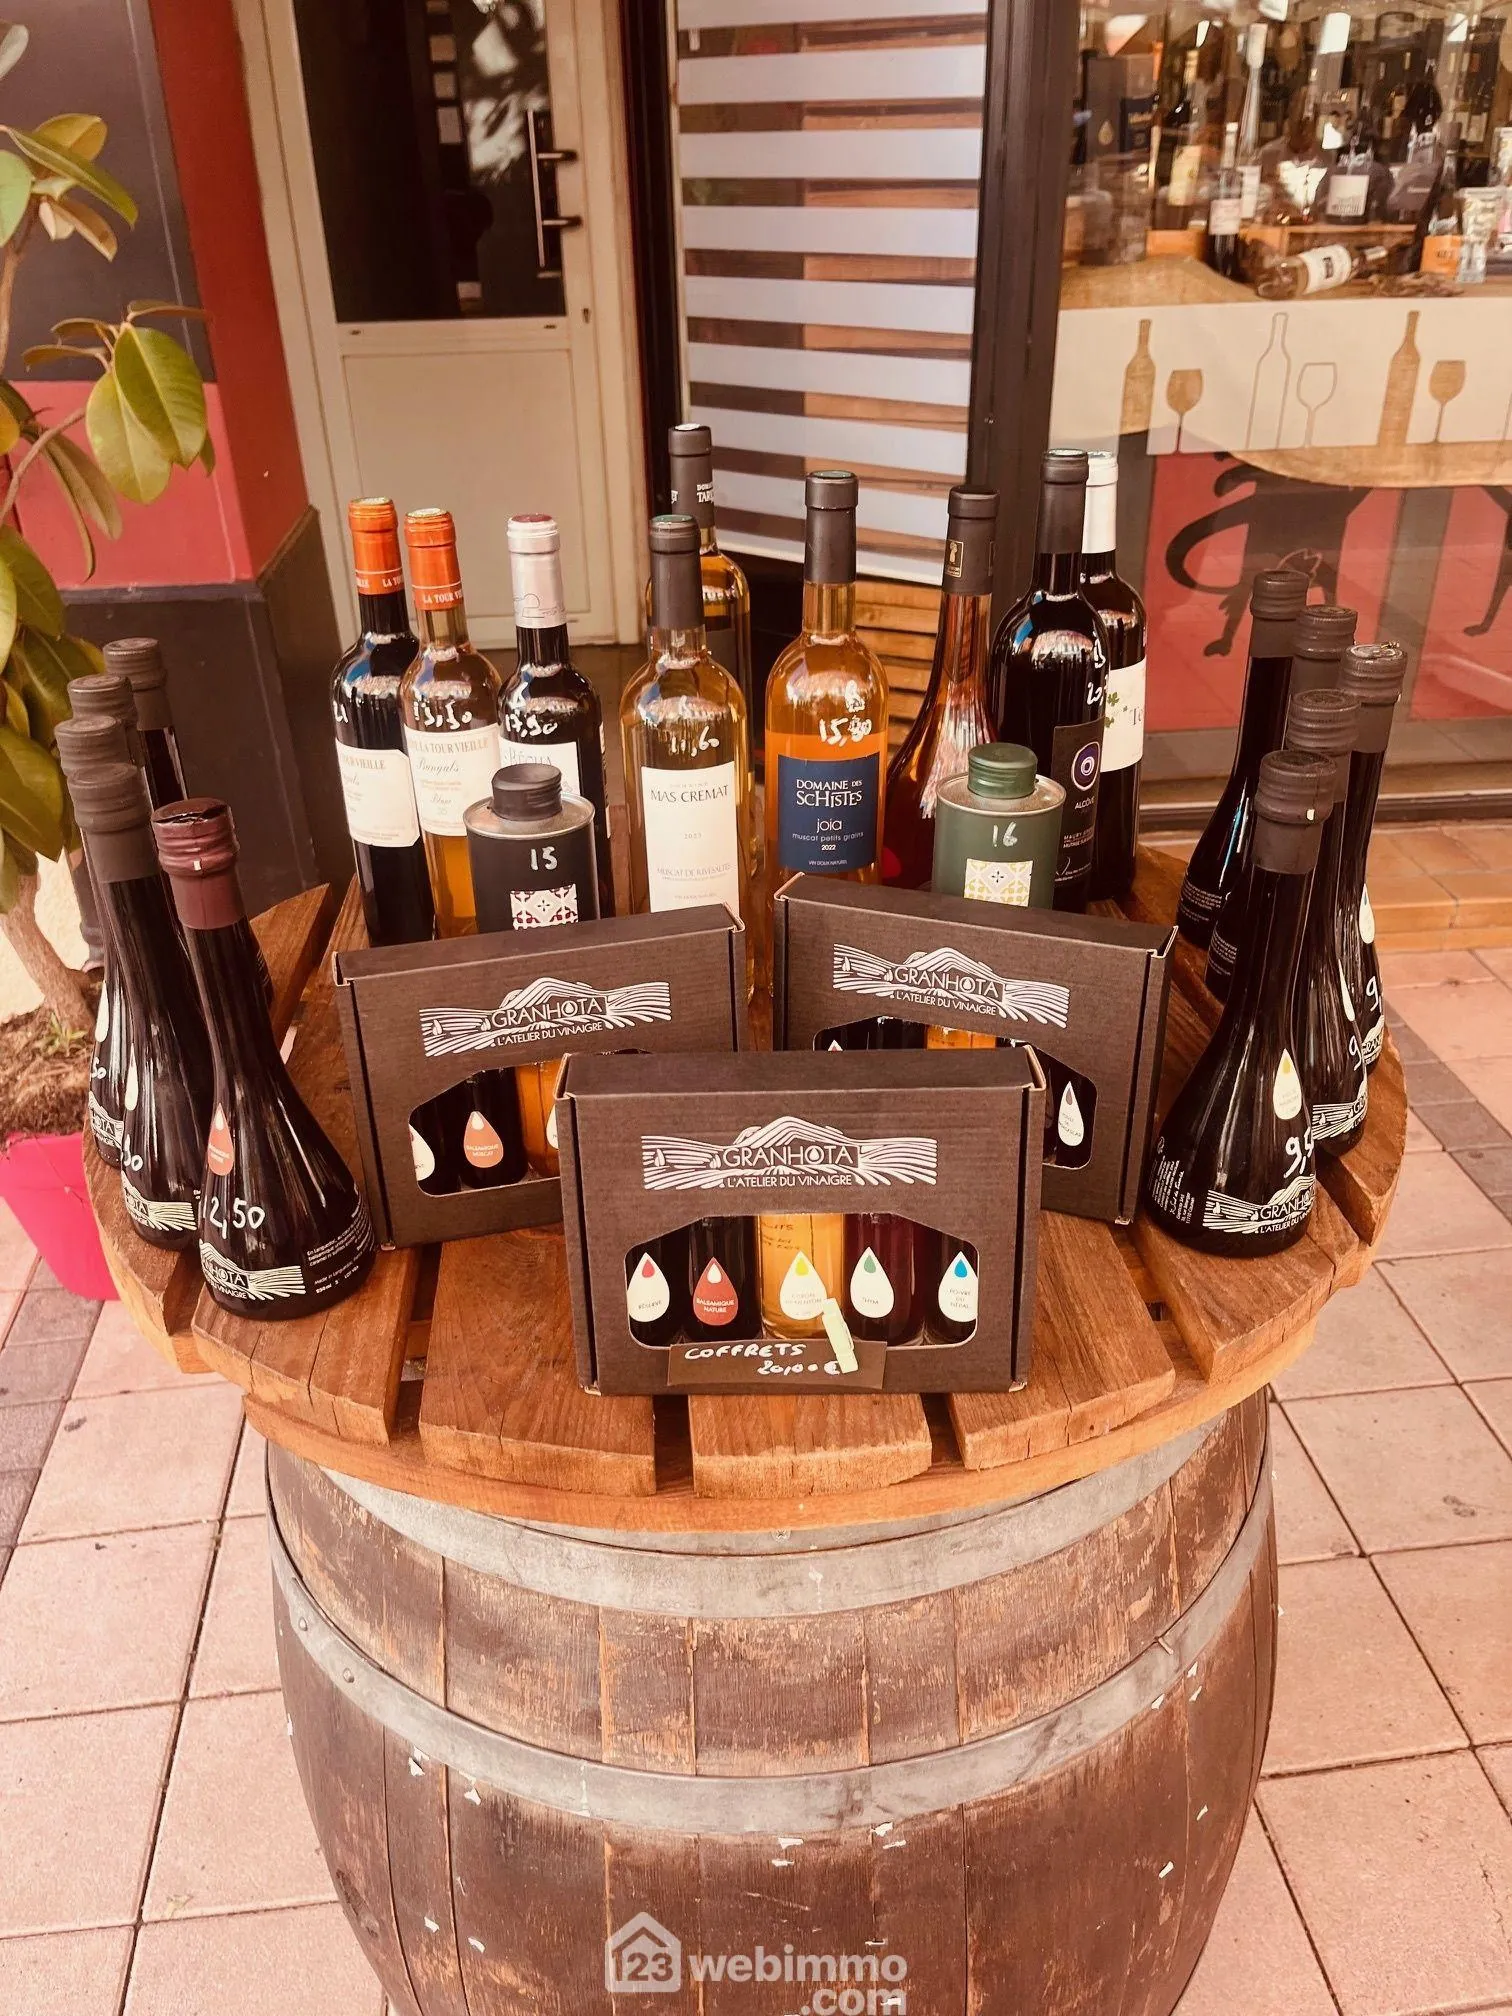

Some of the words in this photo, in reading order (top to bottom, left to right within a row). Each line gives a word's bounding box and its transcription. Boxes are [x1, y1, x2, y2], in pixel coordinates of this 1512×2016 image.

[650, 789, 677, 802] MAS
[681, 784, 729, 803] CREMAT
[796, 779, 849, 791] DOMAINE
[851, 779, 863, 788] DES
[816, 818, 842, 834] joia
[992, 821, 1018, 848] 16
[792, 832, 819, 842] muscat
[820, 833, 841, 843] petits
[843, 831, 864, 842] grains
[895, 966, 999, 998] GRANHOTA
[491, 996, 602, 1029] GRANHOTA
[896, 991, 936, 1006] L'ATELIER
[937, 996, 951, 1008] DU
[952, 1000, 997, 1016] VINAIGRE
[497, 1031, 541, 1046] L'ATELIER
[542, 1028, 556, 1041] DU
[557, 1021, 603, 1039] VINAIGRE
[721, 1145, 853, 1168] GRANHOTA
[727, 1174, 778, 1188] L'ATELIER
[779, 1175, 797, 1187] DU
[797, 1174, 853, 1188] VINAIGRE
[696, 1297, 735, 1307] BALSAMIQUE
[684, 1343, 807, 1360] COFFRETS
